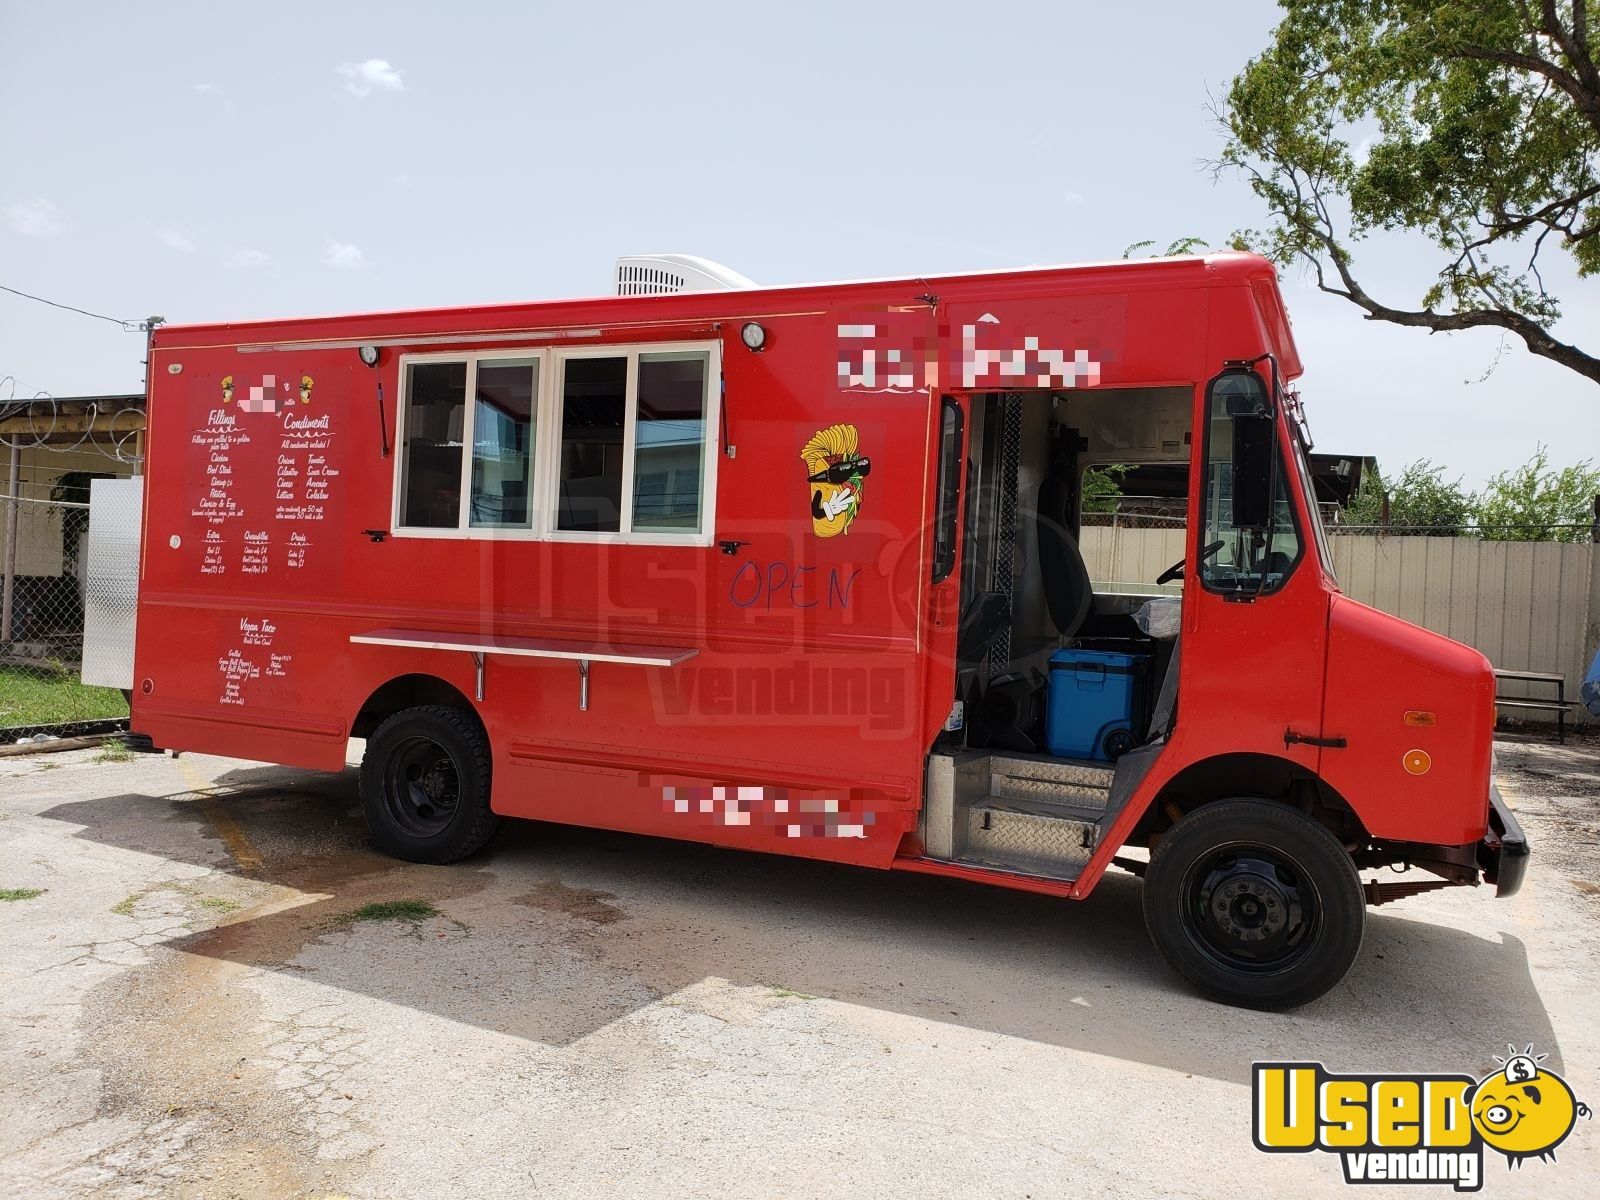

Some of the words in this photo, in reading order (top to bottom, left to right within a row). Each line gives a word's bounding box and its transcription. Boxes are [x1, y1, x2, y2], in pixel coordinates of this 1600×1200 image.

[208, 409, 236, 429] Fillings
[284, 412, 330, 430] Condiments
[281, 439, 290, 448] All
[211, 452, 229, 462] Chicken
[278, 454, 295, 465] Onions
[308, 454, 326, 465] Tomato
[207, 464, 219, 474] Beef
[219, 464, 232, 474] Steak
[277, 465, 299, 476] Cilantro
[307, 465, 320, 476] Sour
[321, 465, 339, 476] Cream
[276, 477, 294, 488] Cheese
[306, 477, 328, 488] Avocado
[276, 489, 295, 499] Lettuce
[306, 488, 329, 500] Coleslaw
[200, 498, 218, 508] Chorizo
[218, 499, 225, 508] &
[226, 498, 236, 510] Egg
[730, 561, 862, 610] OPEN
[240, 618, 259, 633] Vegan
[262, 619, 276, 633] Taco
